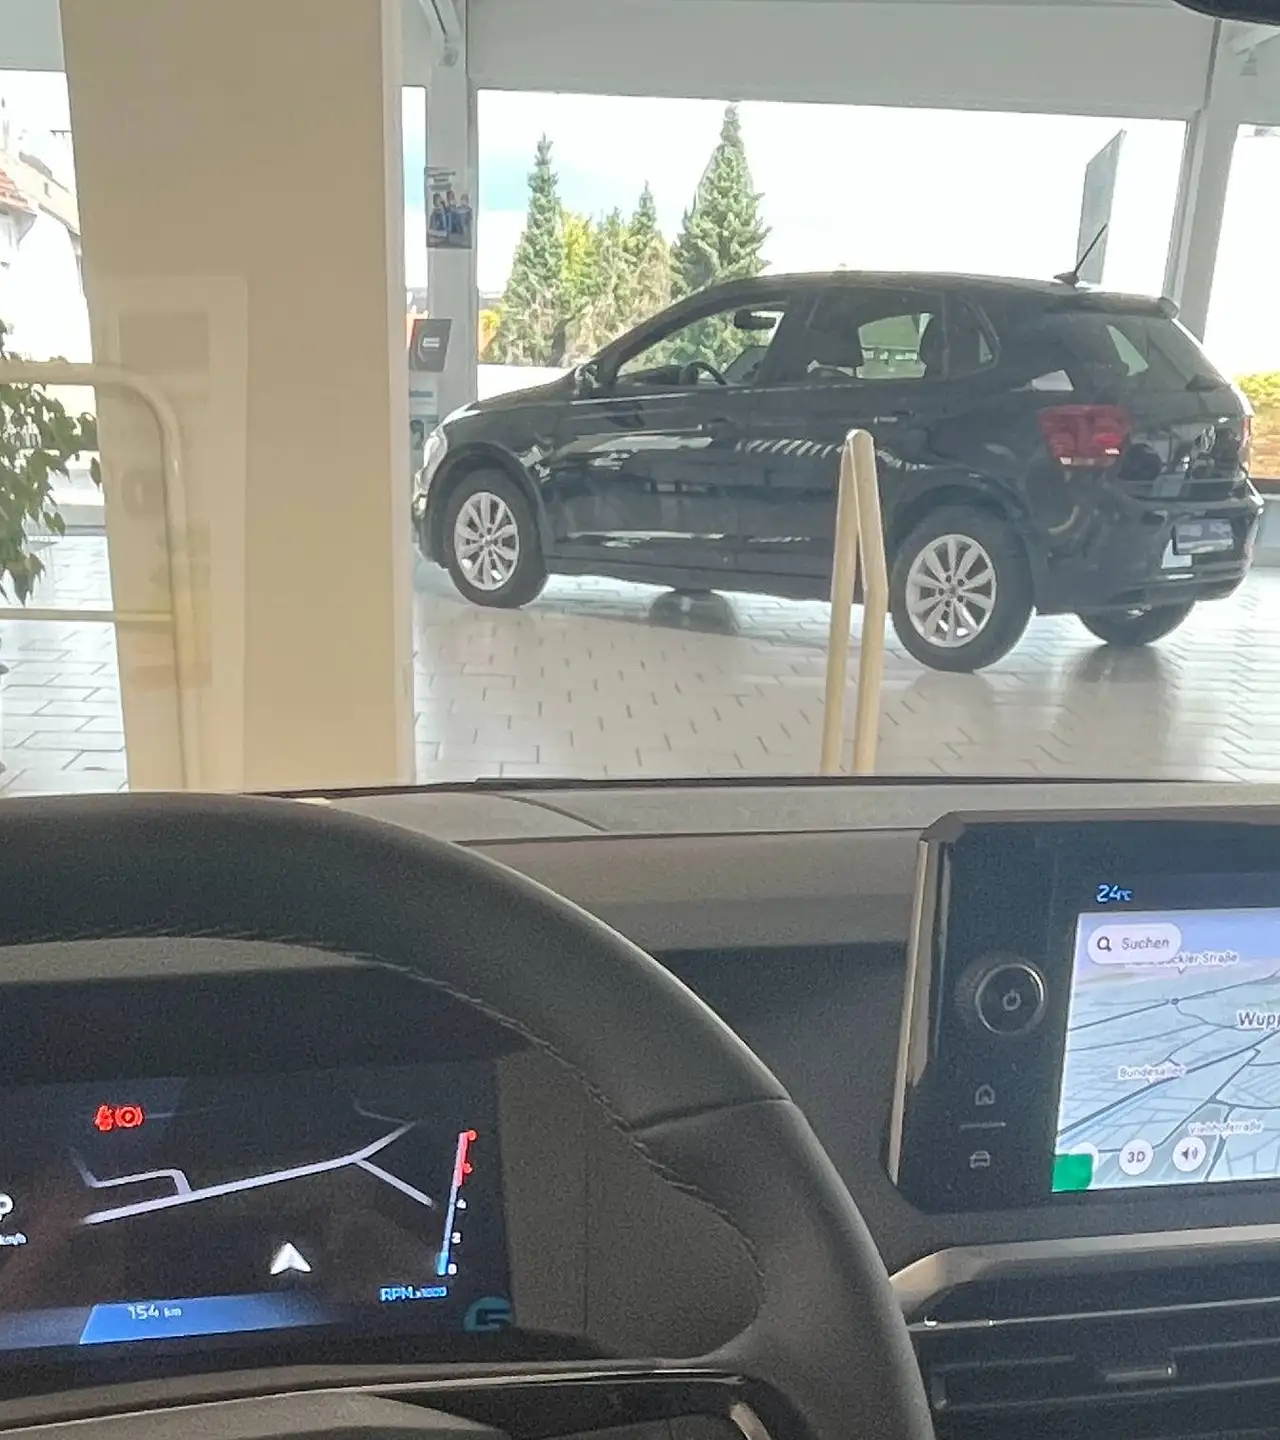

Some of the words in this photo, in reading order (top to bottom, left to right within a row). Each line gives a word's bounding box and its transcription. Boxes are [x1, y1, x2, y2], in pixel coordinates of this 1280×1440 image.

[1121, 938, 1170, 949] Suchen
[1127, 1150, 1146, 1163] 3D
[128, 1305, 160, 1319] 154
[163, 1308, 182, 1317] km
